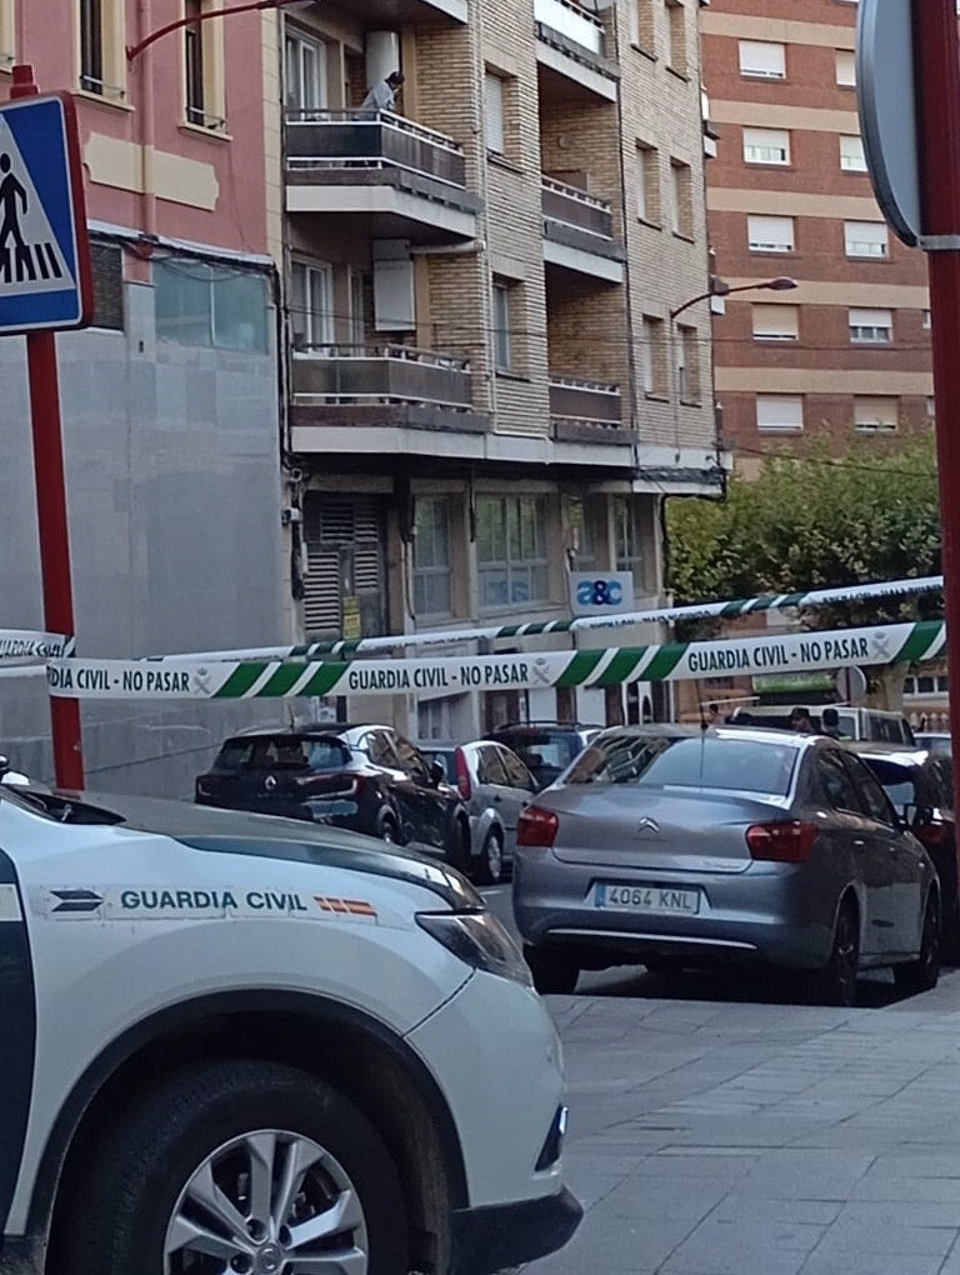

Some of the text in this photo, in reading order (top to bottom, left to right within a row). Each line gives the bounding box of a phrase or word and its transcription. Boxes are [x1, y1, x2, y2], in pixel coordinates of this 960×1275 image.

[577, 580, 623, 606] a&c
[688, 648, 750, 672] GUARDIA
[754, 645, 789, 667] CIVIL
[800, 642, 821, 663] NO
[825, 638, 868, 660] PASAR
[77, 669, 110, 690] CIVIL
[123, 671, 143, 691] NO
[146, 672, 190, 693] PASAR
[349, 668, 410, 690] GUARDIA
[414, 667, 448, 687] CIVIL
[460, 666, 481, 686] NO
[485, 663, 528, 684] PASAR
[120, 890, 308, 911] GUARDIA CIVIL
[609, 888, 692, 910] 4064 KNL
